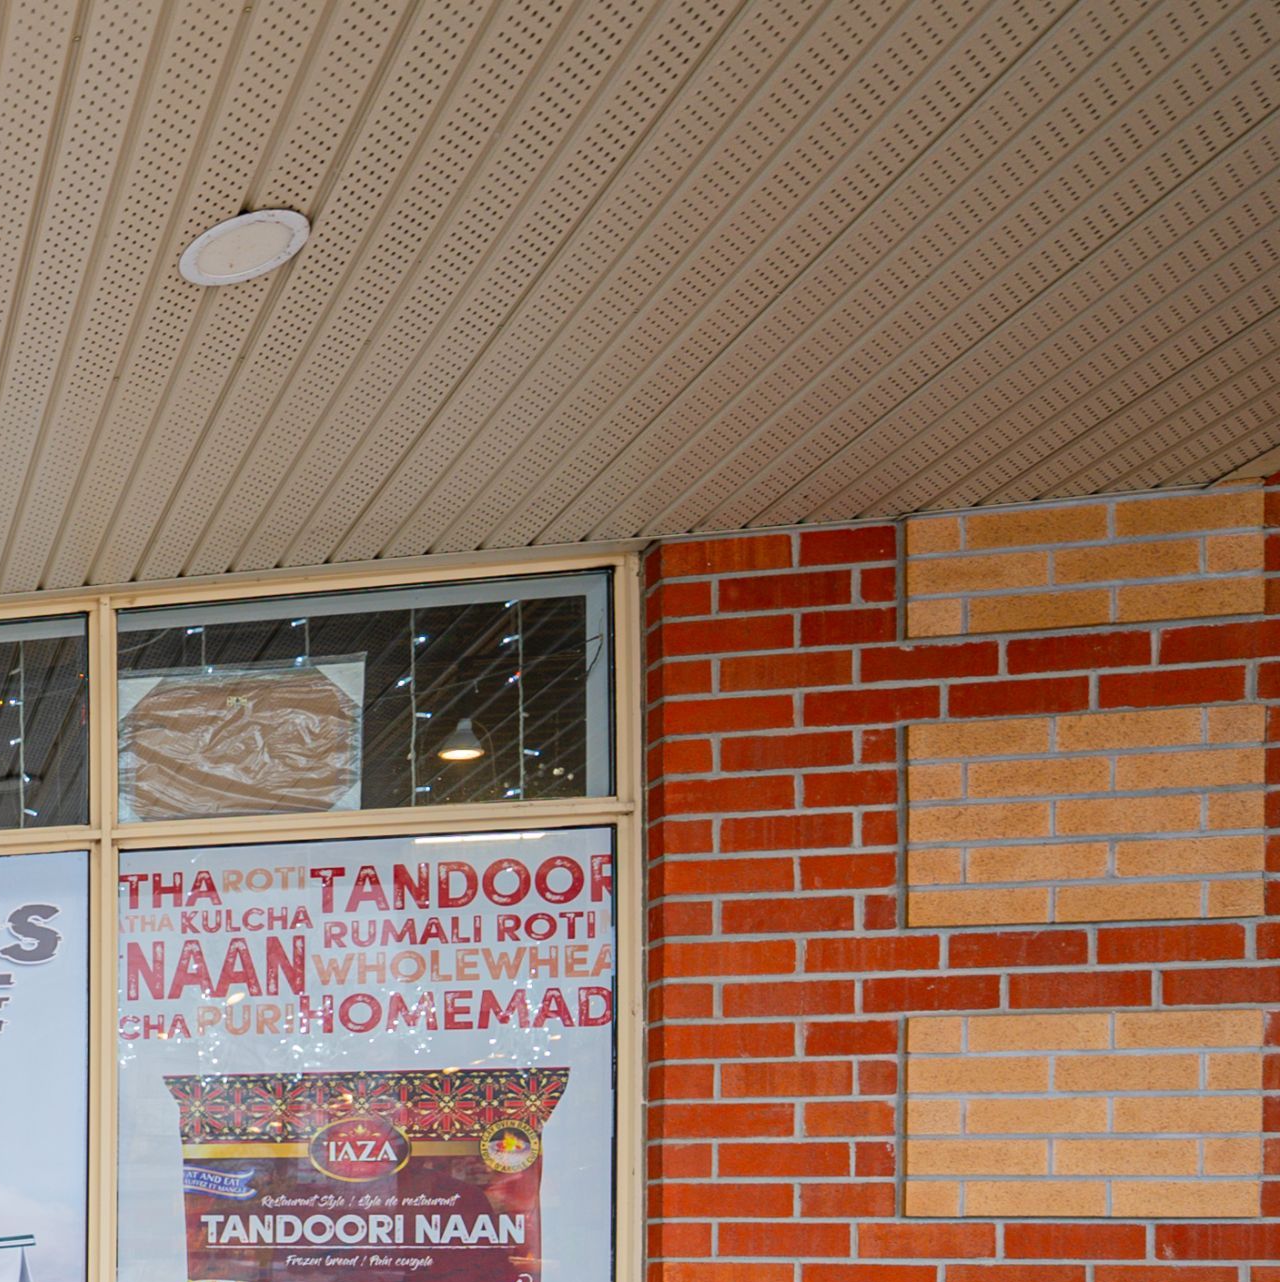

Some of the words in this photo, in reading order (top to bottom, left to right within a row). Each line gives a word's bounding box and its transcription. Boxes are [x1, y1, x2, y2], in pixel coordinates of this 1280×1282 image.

[222, 865, 306, 893] ROTI
[180, 905, 314, 934] KULCHA
[323, 914, 483, 949] RUMALI
[496, 910, 596, 942] ROTI
[126, 935, 306, 1001] NAAN
[196, 1003, 295, 1036] PURI
[324, 1139, 399, 1163] TAZA
[200, 1173, 221, 1184] AND
[223, 1179, 240, 1187] EAT
[261, 1194, 319, 1208] Restaurant
[318, 1193, 345, 1210] Style
[357, 1194, 382, 1210] style
[385, 1194, 399, 1207] de
[402, 1192, 462, 1207] restaurant
[200, 1214, 405, 1244] TANDOORI
[415, 1213, 526, 1244] NAAN
[286, 1255, 322, 1267] Frozen
[324, 1255, 358, 1267] bread
[368, 1255, 393, 1267] Pain
